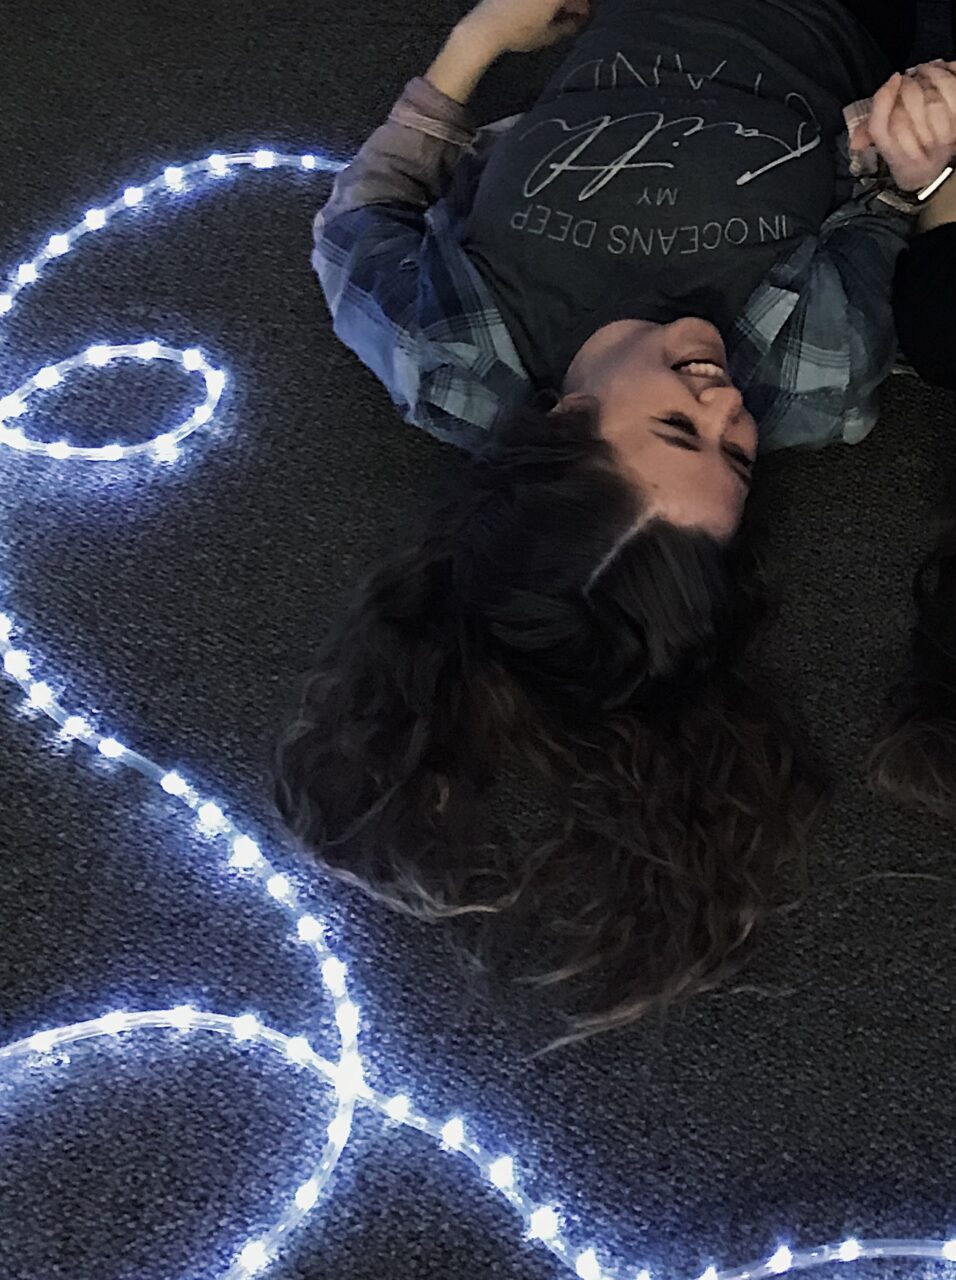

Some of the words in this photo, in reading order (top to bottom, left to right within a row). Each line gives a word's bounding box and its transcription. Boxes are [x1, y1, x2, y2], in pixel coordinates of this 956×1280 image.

[636, 188, 678, 206] MY
[511, 204, 597, 248] DEEP
[607, 217, 750, 256] OCEANS
[759, 215, 787, 243] IN
